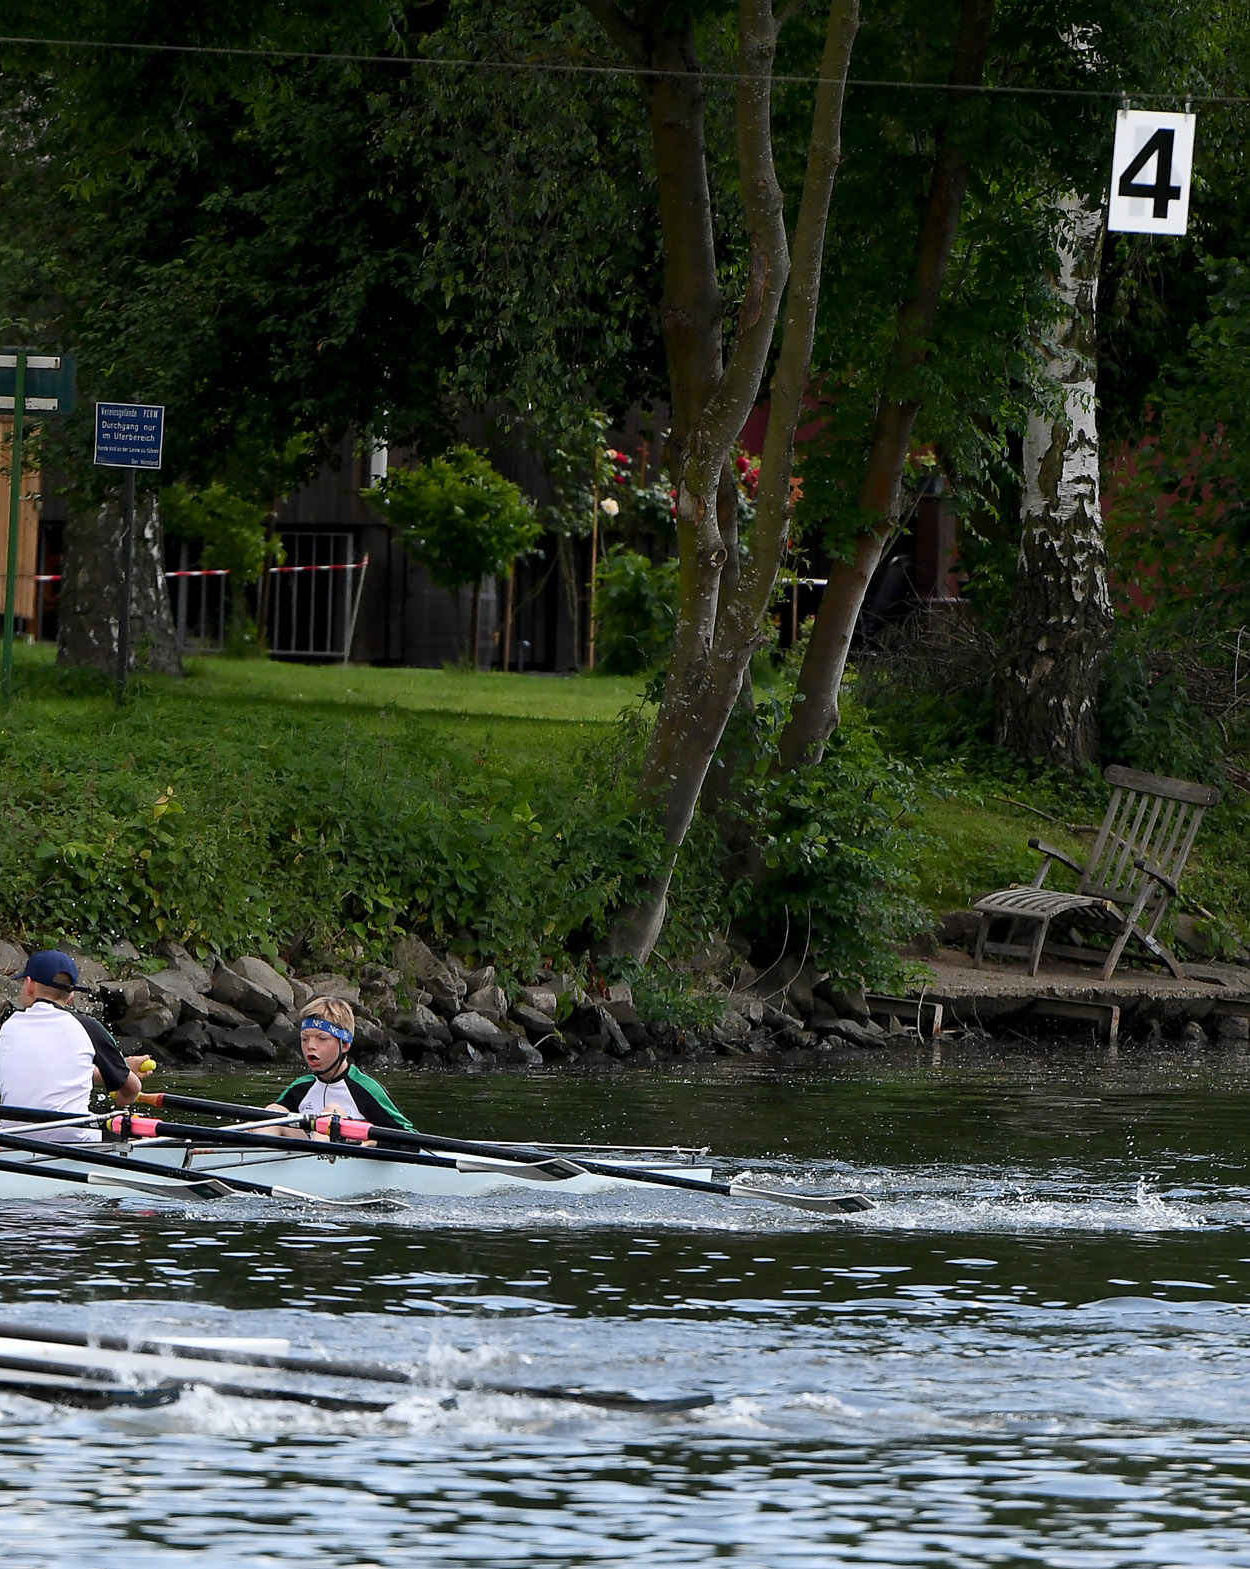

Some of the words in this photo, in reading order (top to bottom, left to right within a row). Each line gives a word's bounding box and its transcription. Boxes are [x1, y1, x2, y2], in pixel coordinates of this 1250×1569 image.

[1118, 128, 1181, 219] 4
[101, 420, 139, 432] Durchgang
[113, 432, 155, 442] Uferbereich
